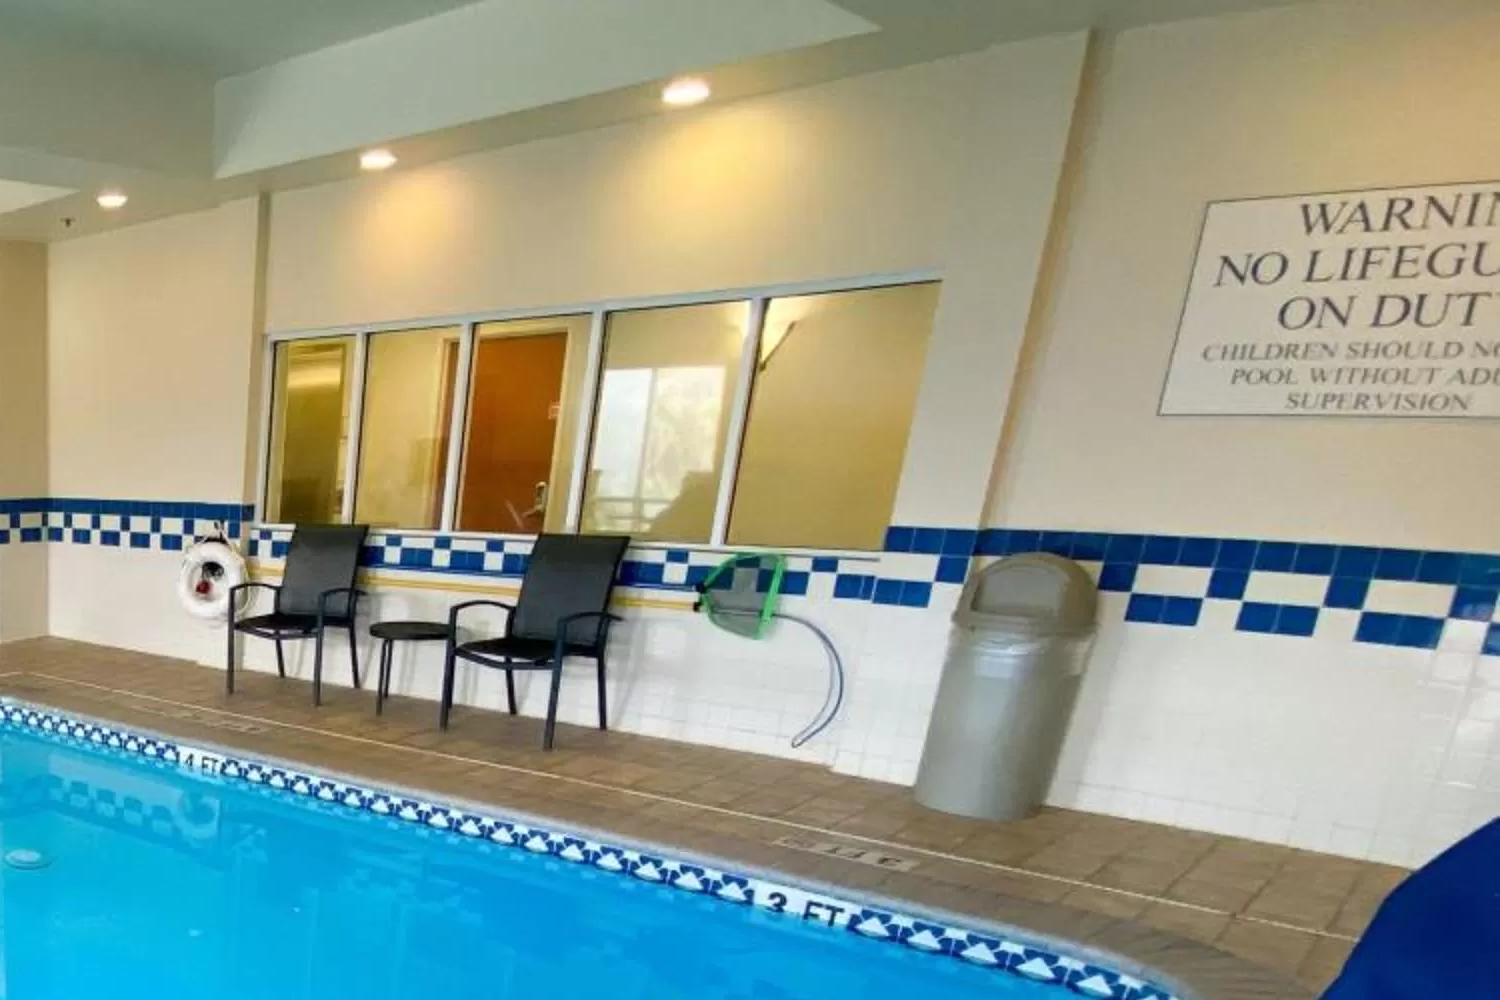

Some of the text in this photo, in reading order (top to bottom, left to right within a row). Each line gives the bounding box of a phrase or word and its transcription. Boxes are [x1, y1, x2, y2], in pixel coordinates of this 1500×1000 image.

[1212, 251, 1289, 287] NO
[1277, 291, 1500, 330] ON DUT
[1201, 341, 1337, 362] CHILDREN
[1345, 340, 1464, 360] SHOULD
[1230, 367, 1300, 385] POOL
[1309, 366, 1443, 386] WITHOUT
[1284, 391, 1475, 412] SUPERVISION
[185, 753, 219, 773] 4 FT
[766, 891, 845, 927] 3 FT
